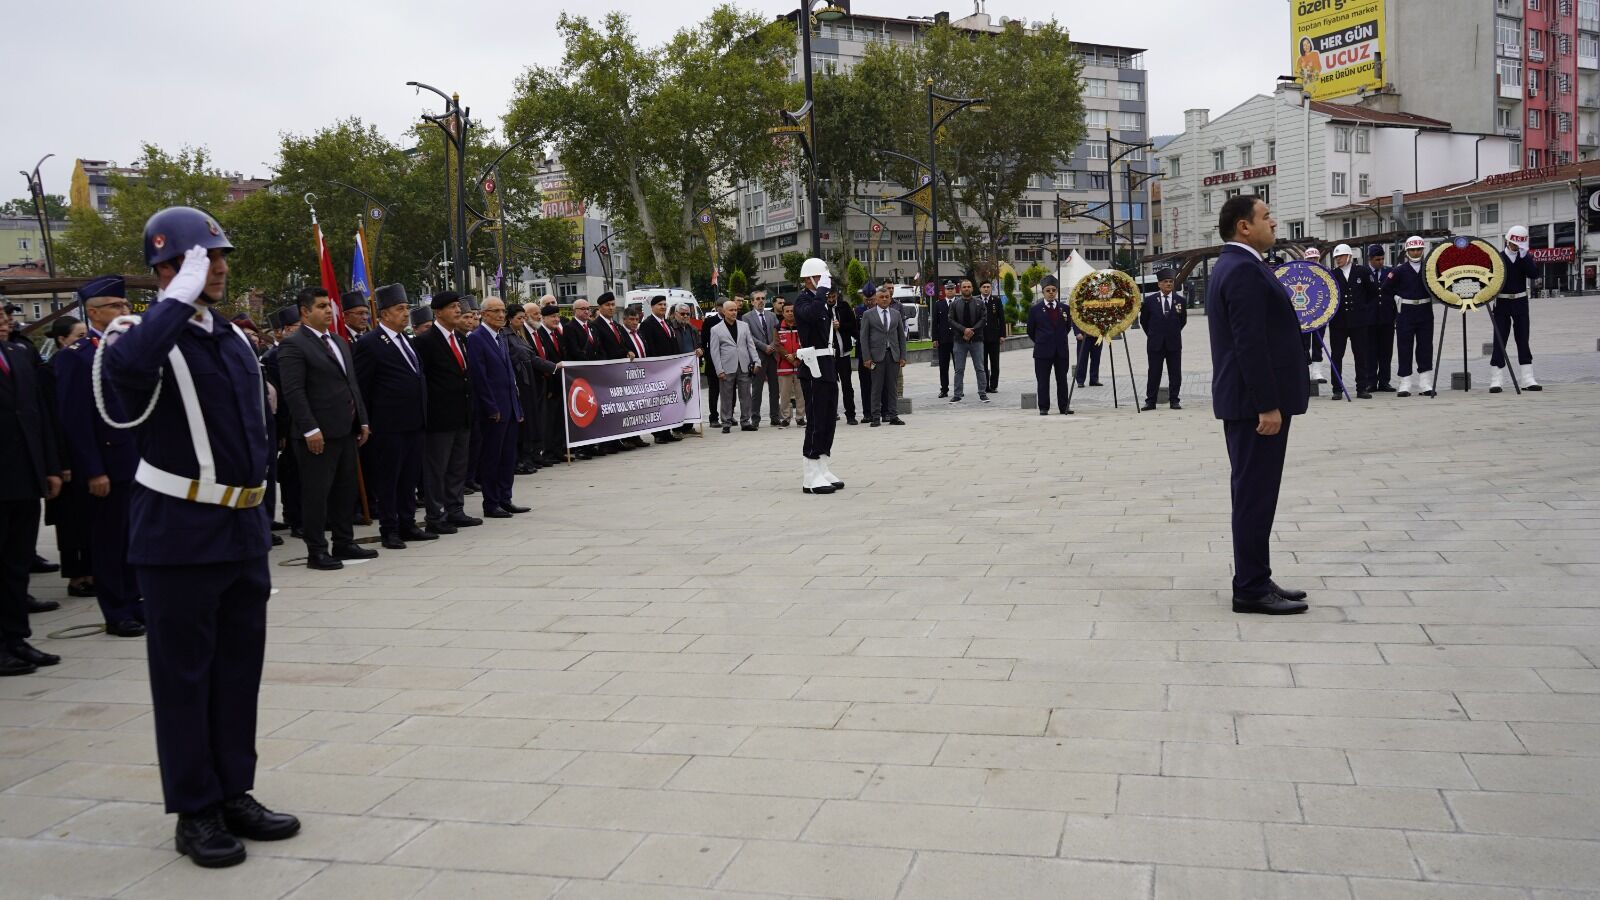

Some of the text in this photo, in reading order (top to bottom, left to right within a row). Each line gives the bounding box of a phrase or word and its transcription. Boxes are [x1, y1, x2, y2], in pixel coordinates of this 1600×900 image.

[1298, 0, 1330, 17] özen
[1298, 21, 1321, 33] toptan
[1323, 14, 1350, 26] fiyatına
[1351, 5, 1378, 18] market
[1320, 24, 1373, 50] HER GÜN
[1325, 43, 1370, 69] UCUZ
[1320, 74, 1334, 84] HER
[1335, 68, 1356, 81] ÜRÜN
[1203, 172, 1238, 187] OTEL
